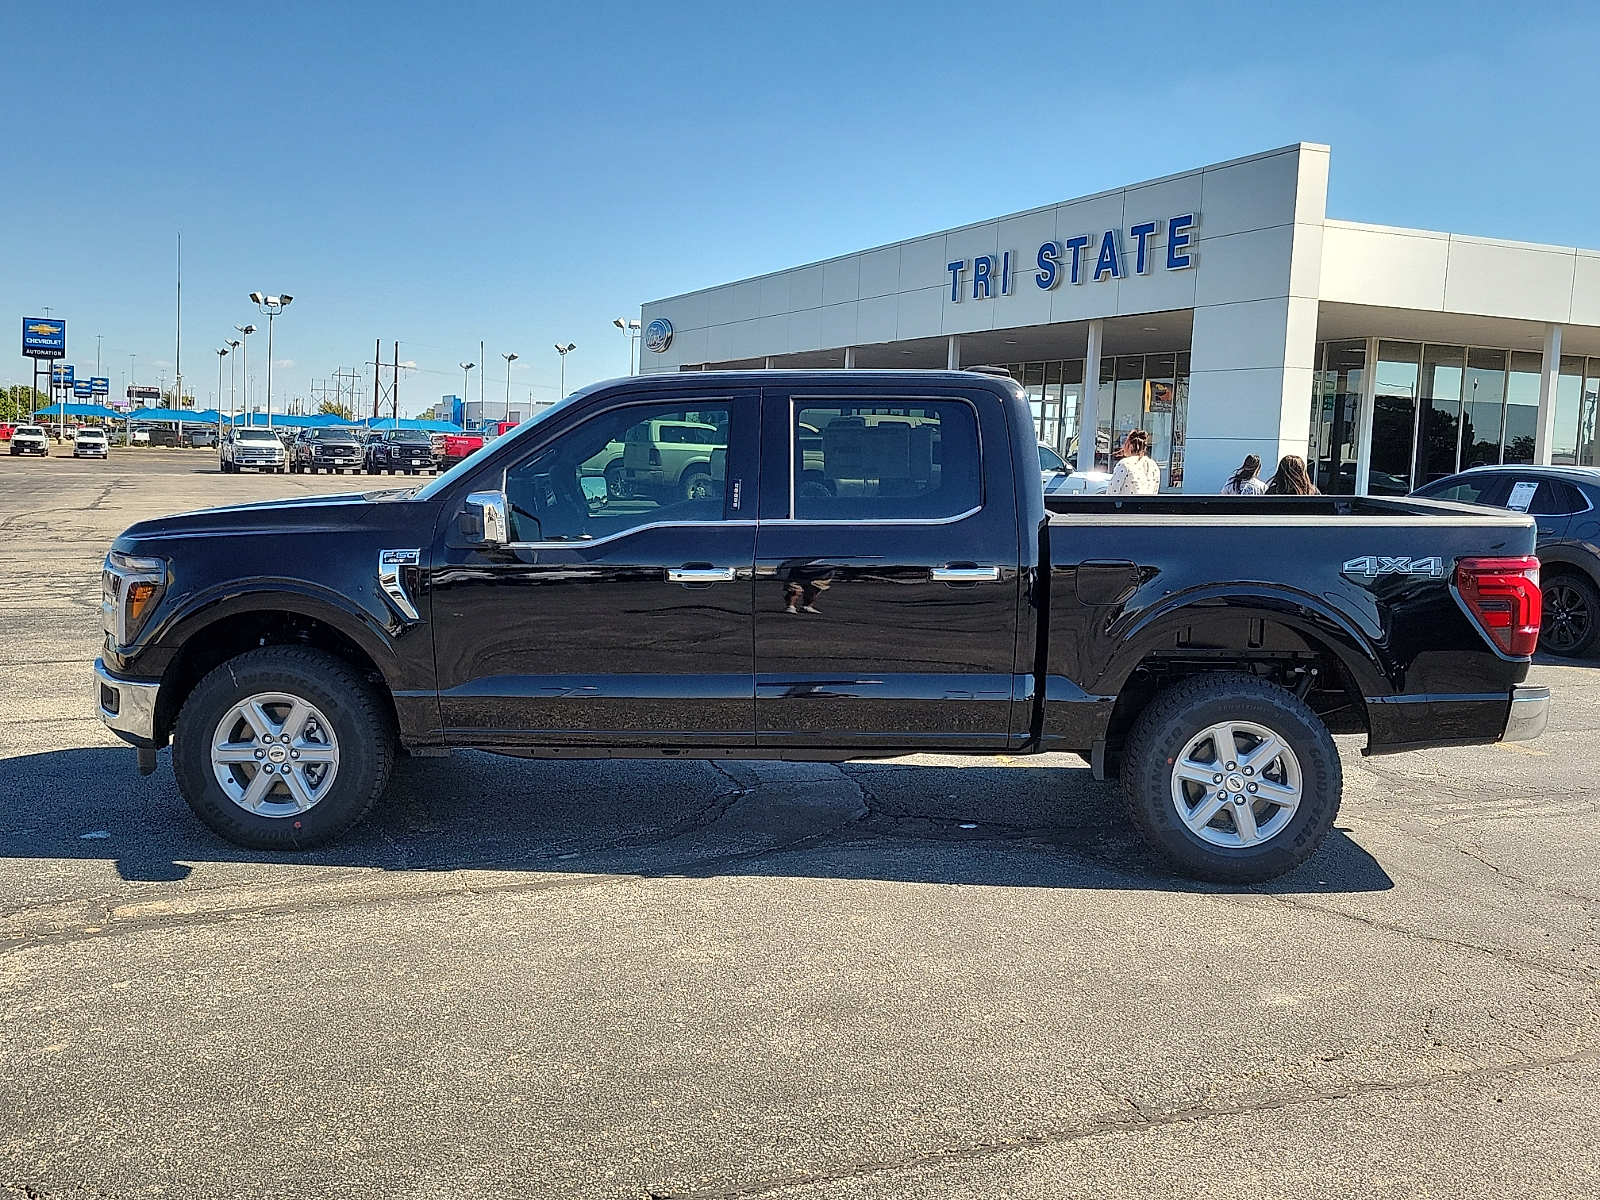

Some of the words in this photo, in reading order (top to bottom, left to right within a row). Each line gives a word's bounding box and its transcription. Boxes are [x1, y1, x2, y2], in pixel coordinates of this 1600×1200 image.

[947, 250, 1015, 304] TRI
[1035, 212, 1198, 291] STATE
[25, 348, 62, 357] AUTONATION
[26, 337, 62, 346] CHEVROLET
[1150, 725, 1184, 824] WRANGLER
[1292, 747, 1328, 848] GOODYEAR
